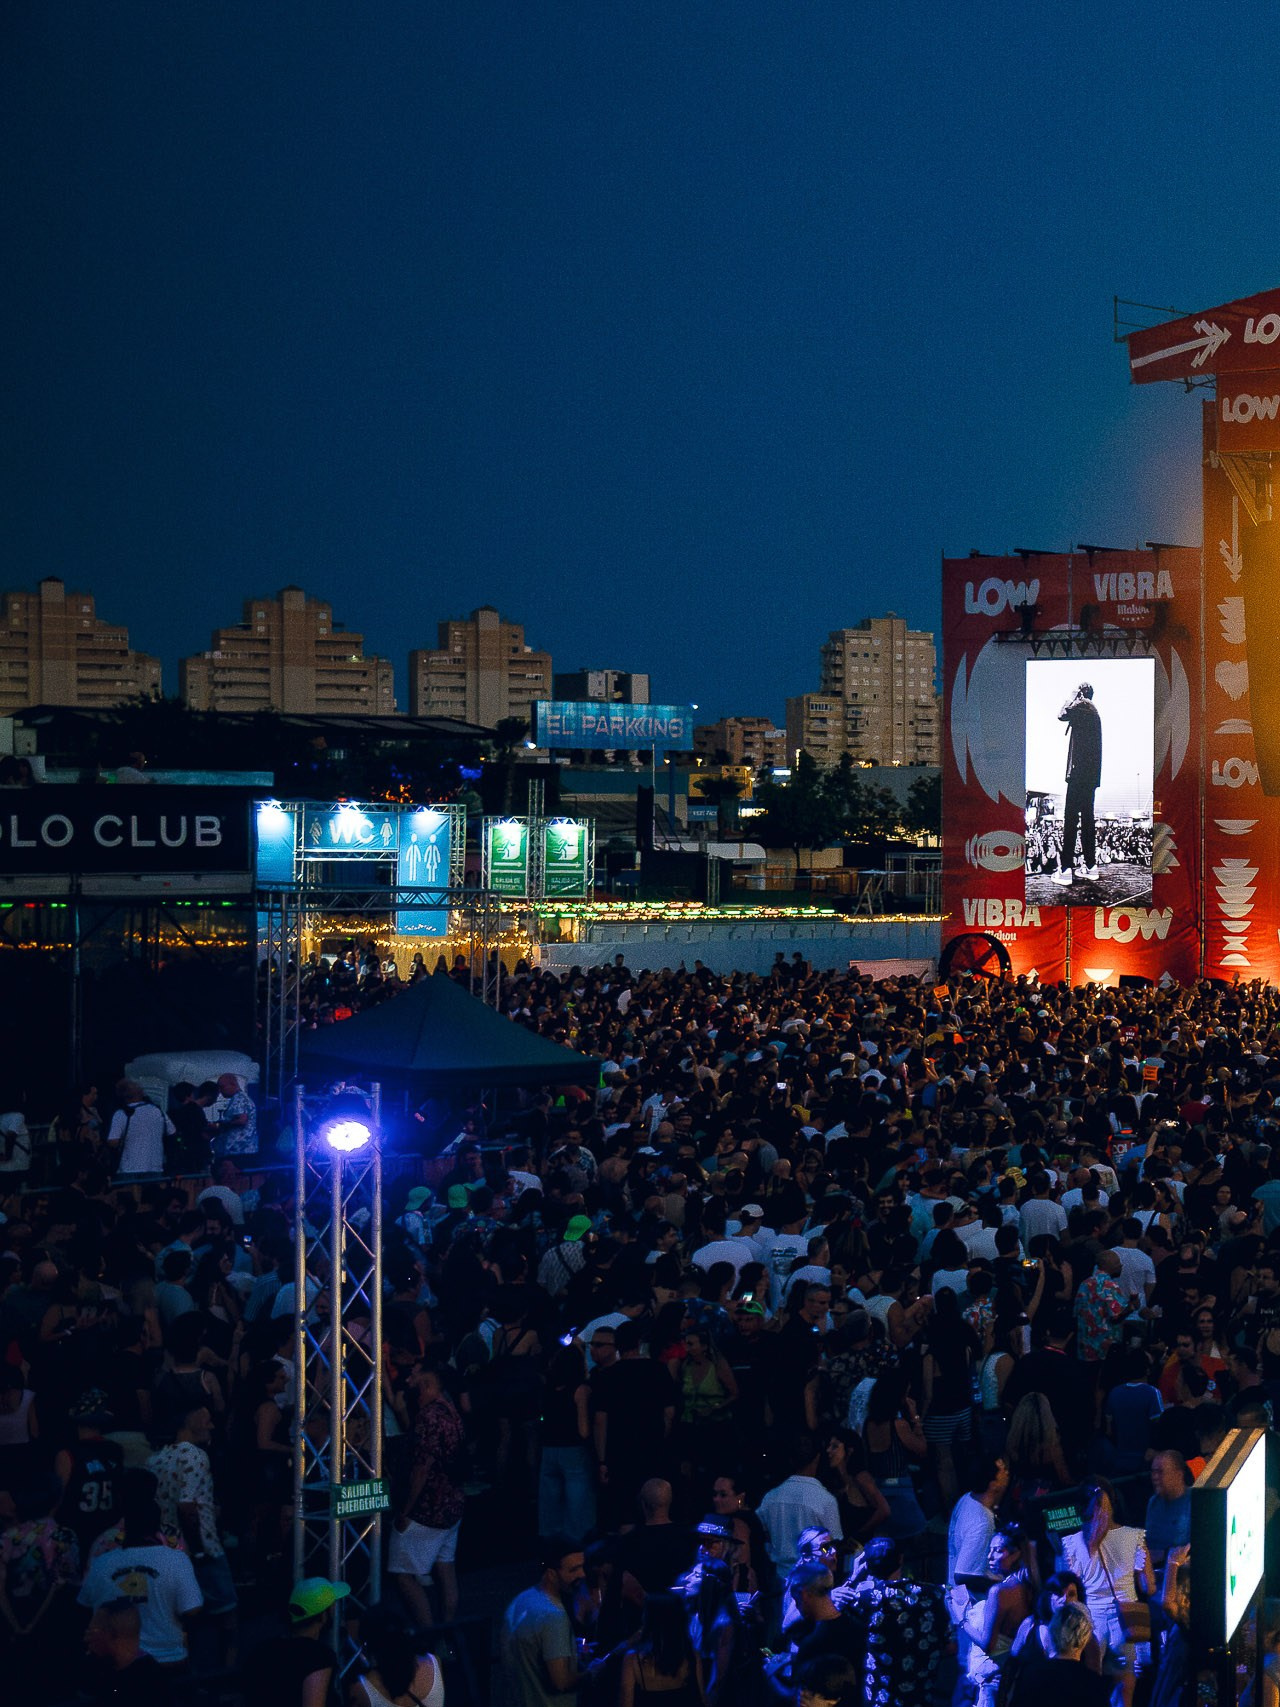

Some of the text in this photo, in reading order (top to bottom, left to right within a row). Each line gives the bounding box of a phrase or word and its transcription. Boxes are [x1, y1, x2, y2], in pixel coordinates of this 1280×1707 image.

[1222, 393, 1280, 423] LOW
[964, 577, 1040, 616] LOW
[1093, 570, 1174, 601] VIBRA
[547, 714, 574, 735] EL
[0, 814, 222, 847] LO CLUB
[328, 818, 375, 844] WC
[963, 898, 1042, 927] VIBRA
[1094, 906, 1173, 944] LOW
[79, 1481, 112, 1513] 35
[337, 1495, 389, 1514] EMERGENCIA
[341, 1481, 383, 1499] SALIDA DE
